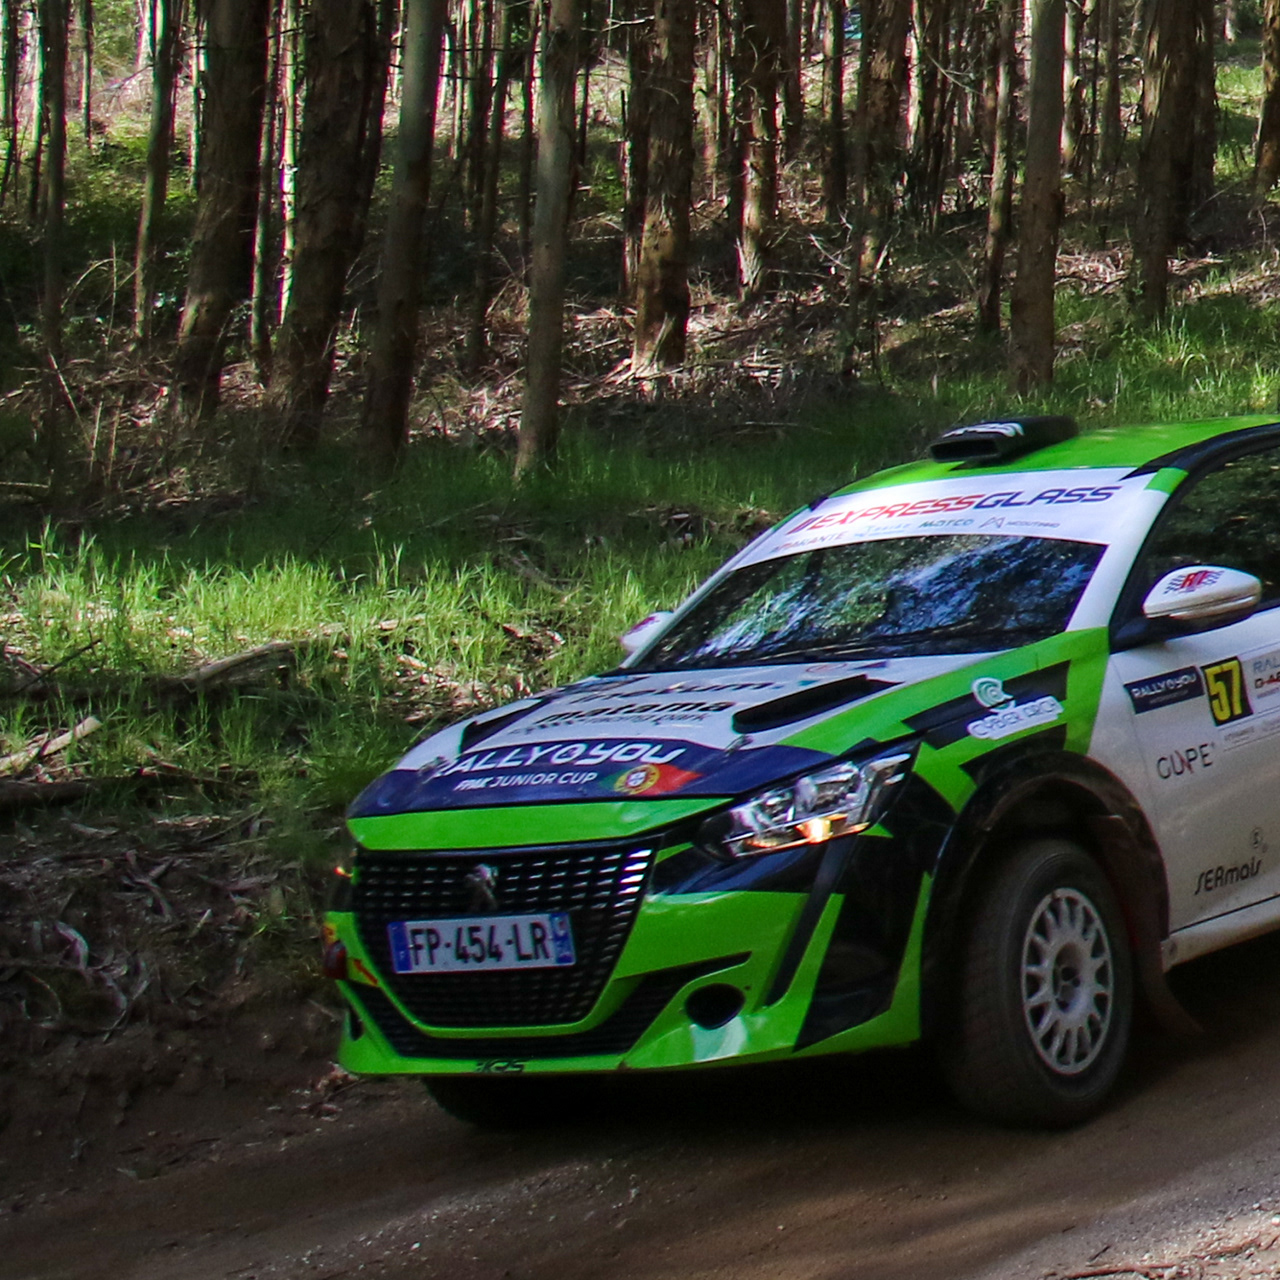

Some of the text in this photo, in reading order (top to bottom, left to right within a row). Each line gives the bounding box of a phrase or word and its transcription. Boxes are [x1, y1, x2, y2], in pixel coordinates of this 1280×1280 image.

[807, 485, 1123, 530] EXPRESSGLASS
[1202, 659, 1244, 722] 57
[488, 772, 559, 789] JUNIOR
[557, 771, 599, 785] CUP
[409, 921, 551, 966] FP-454-LR
